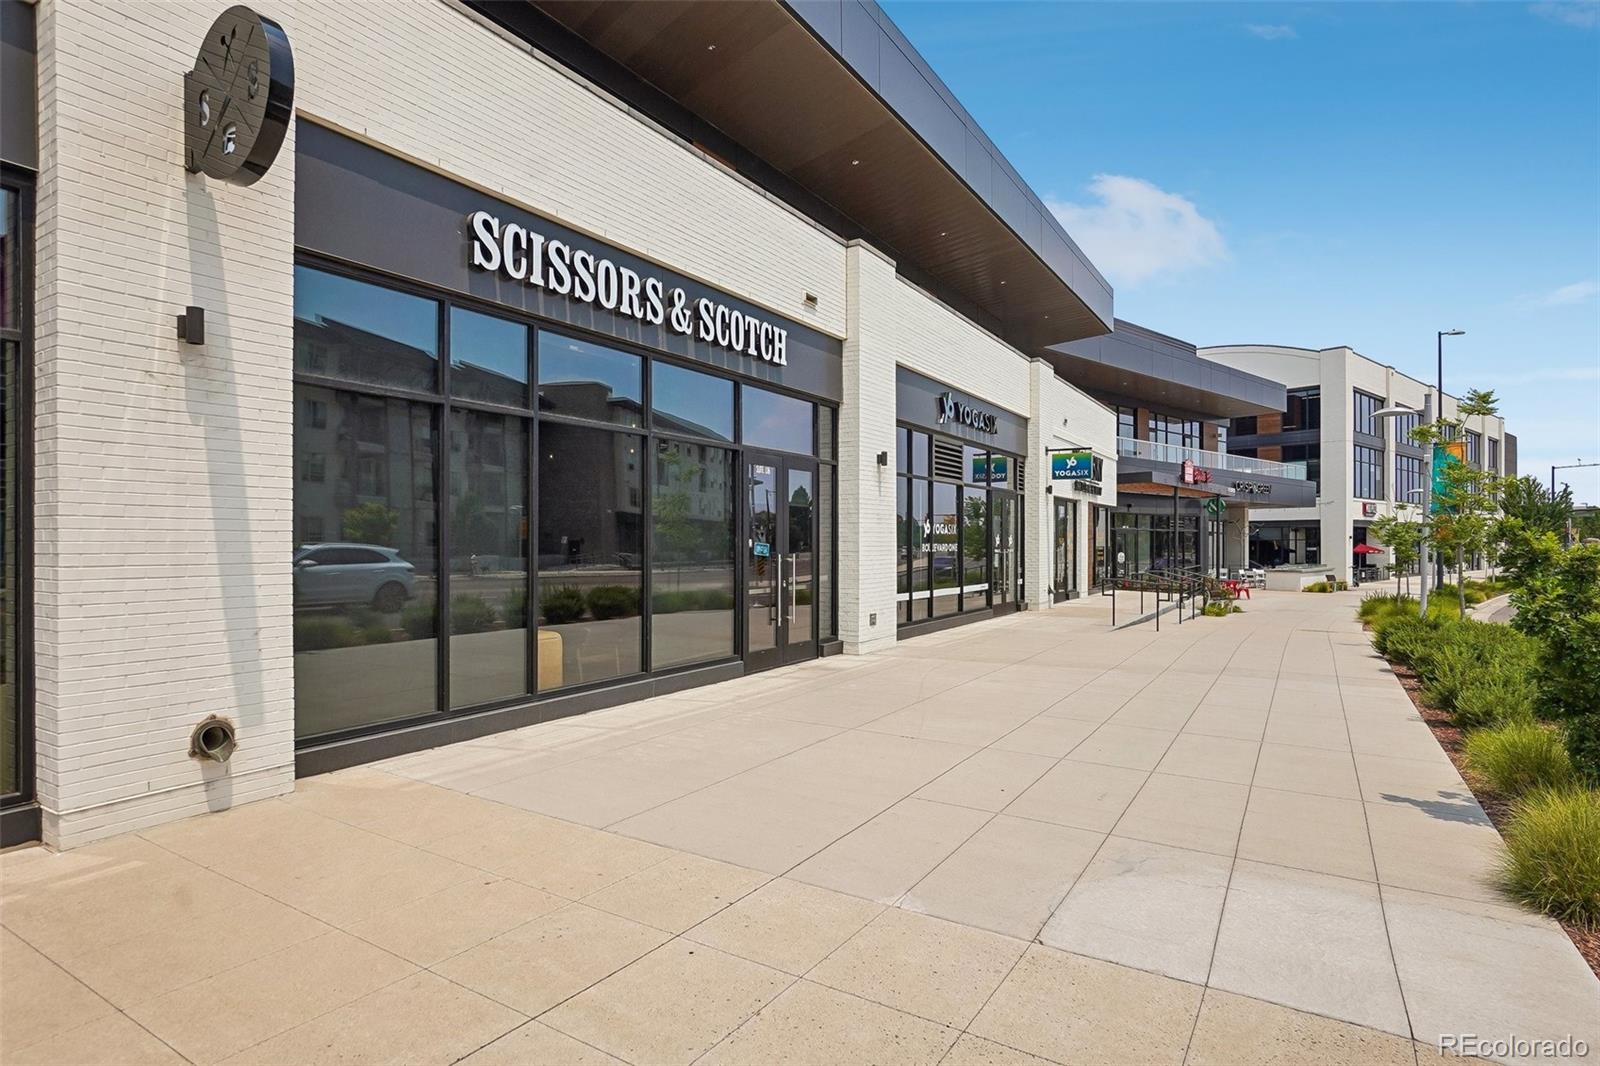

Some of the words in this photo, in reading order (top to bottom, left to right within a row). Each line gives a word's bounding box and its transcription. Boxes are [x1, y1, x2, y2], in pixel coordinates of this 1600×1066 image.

[469, 211, 664, 326] SCISSORS
[667, 287, 693, 336] &
[696, 297, 788, 366] SCOTCH
[957, 402, 998, 435] YOGASIX
